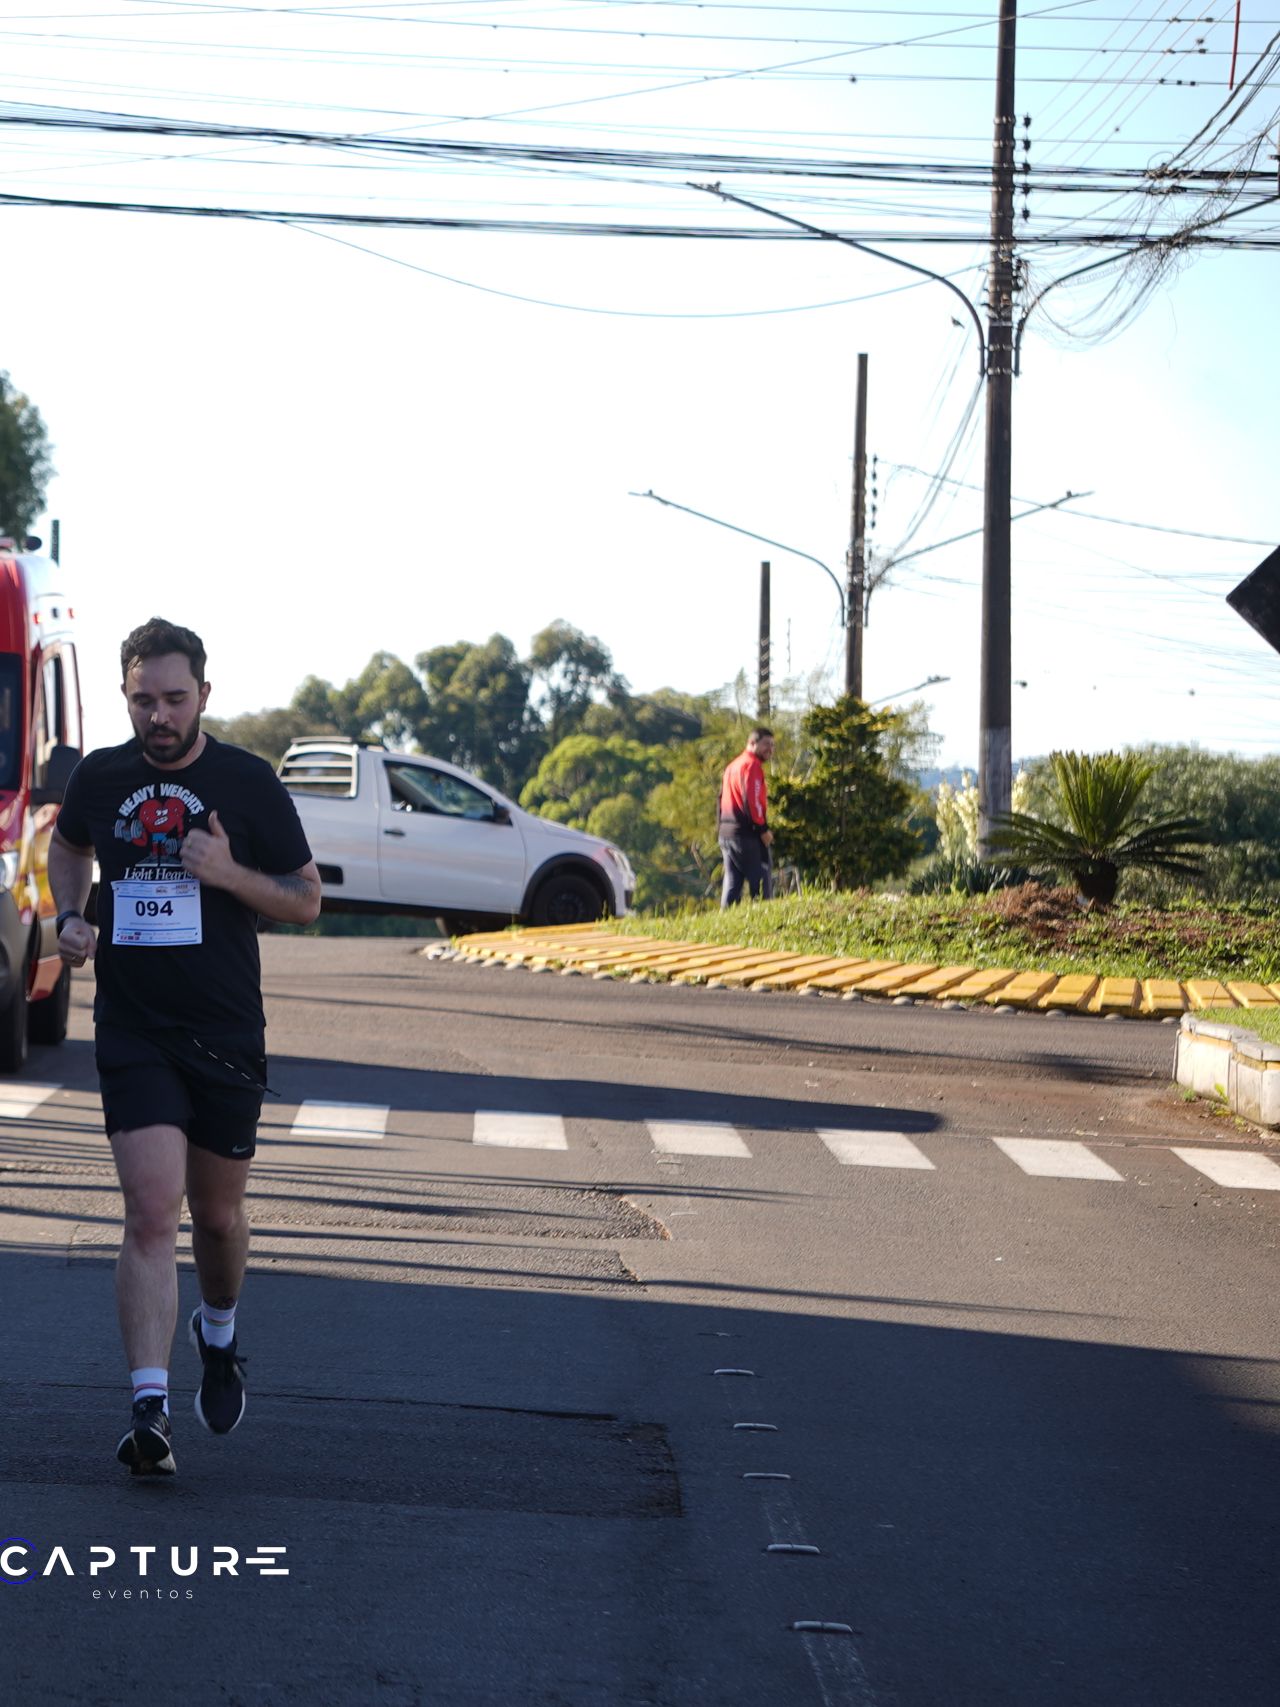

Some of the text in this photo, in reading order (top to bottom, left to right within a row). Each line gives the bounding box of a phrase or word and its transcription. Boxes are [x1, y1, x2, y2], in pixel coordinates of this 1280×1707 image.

[118, 783, 204, 817] HEAVY WEIGHTS
[124, 867, 153, 880] Light
[135, 900, 173, 917] 094
